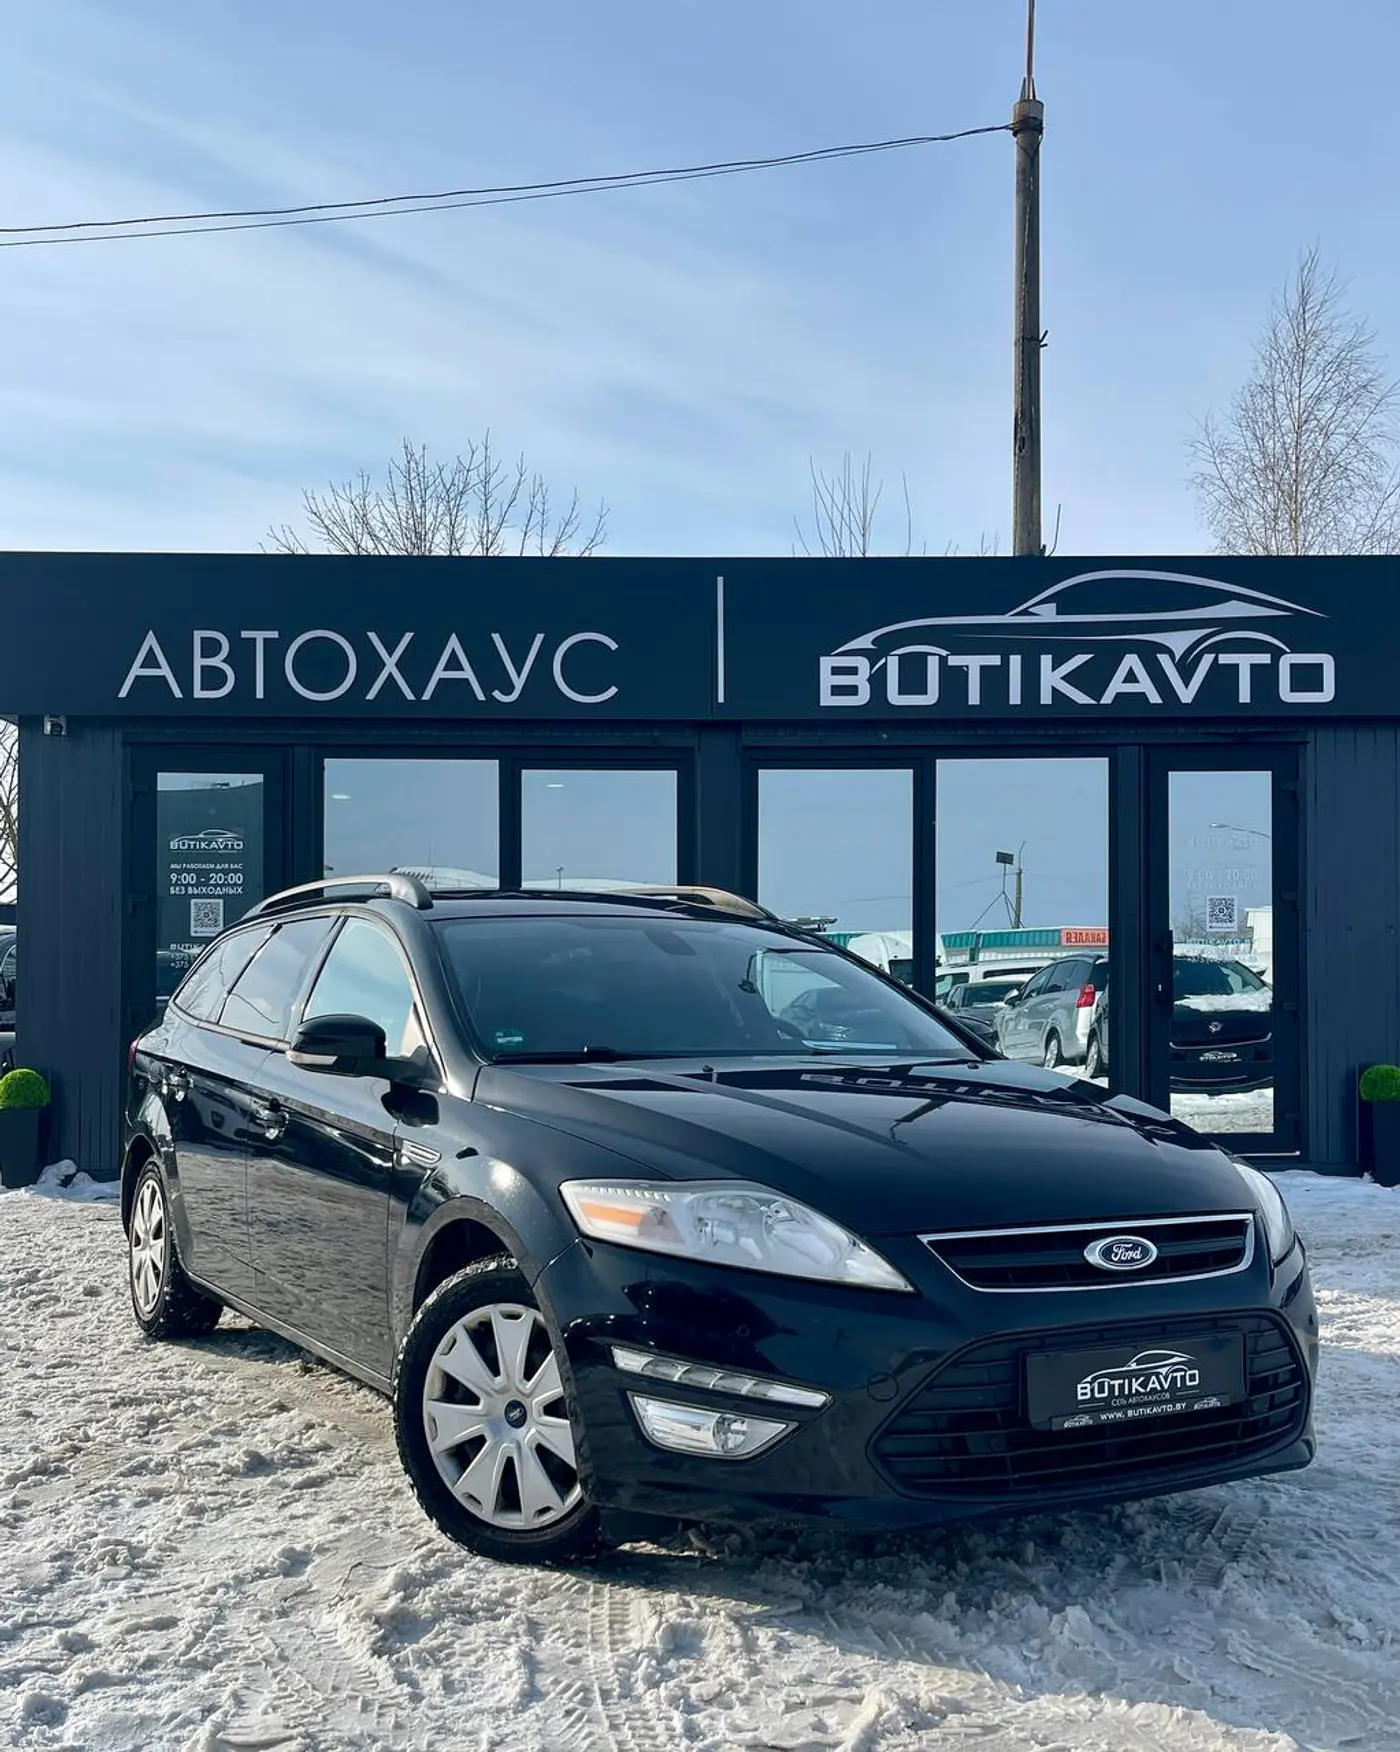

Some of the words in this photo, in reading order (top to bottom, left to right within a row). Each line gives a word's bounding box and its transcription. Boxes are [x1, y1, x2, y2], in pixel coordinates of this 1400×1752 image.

[117, 629, 620, 704] АВТОХАУС
[819, 652, 1336, 708] BUTIKAVTO
[169, 840, 244, 850] BUTIKAVTO
[169, 873, 197, 884] 9:00
[209, 873, 244, 884] 20:00
[169, 886, 185, 895] БЕЗ
[187, 886, 244, 895] ВЫХОДНЫХ
[1111, 1242, 1143, 1263] Ford
[1076, 1369, 1200, 1401] BUTIKAVTO
[1127, 1402, 1187, 1418] BUTIKAVTO.BY
